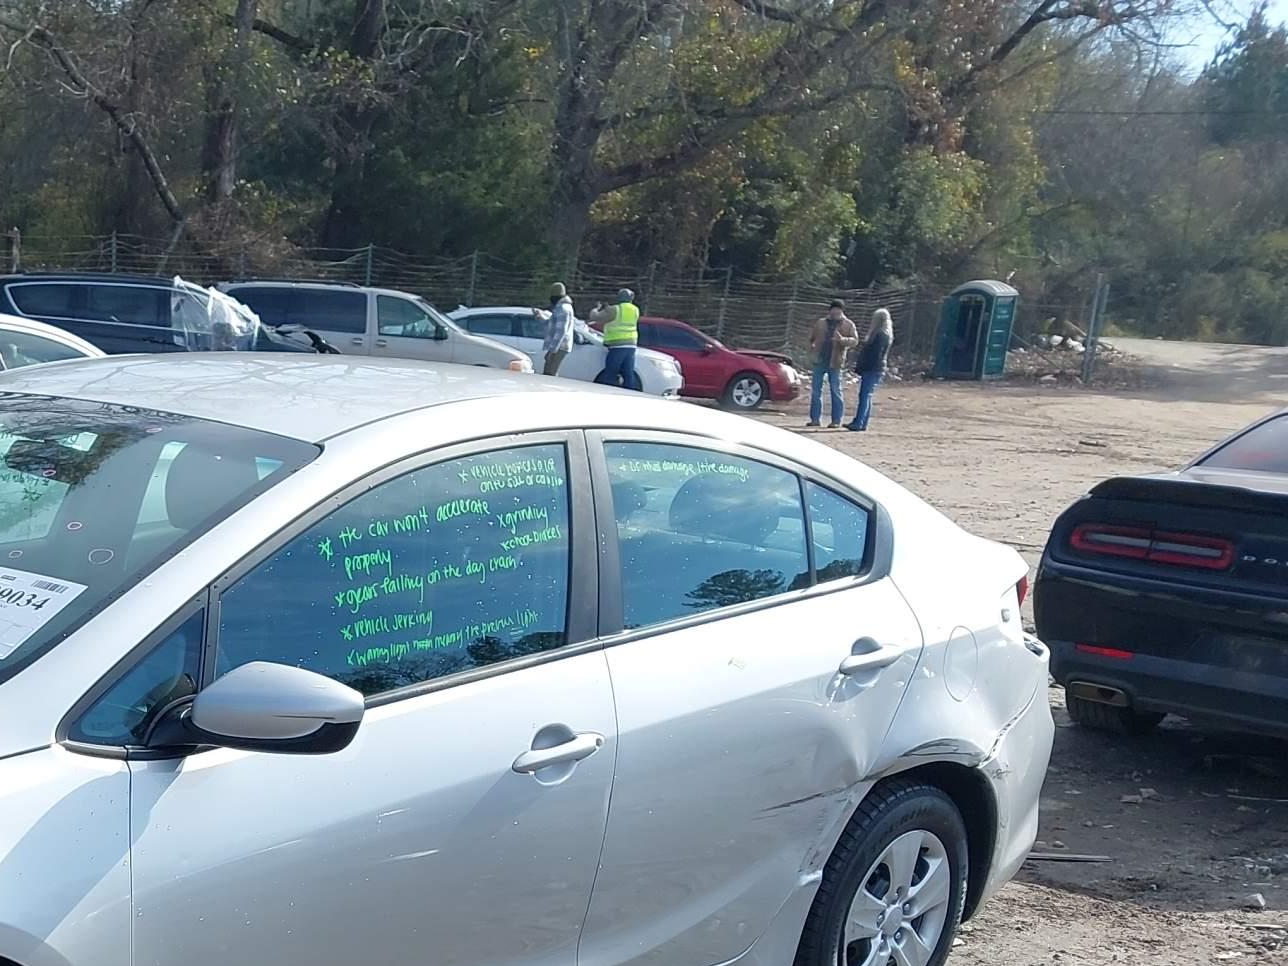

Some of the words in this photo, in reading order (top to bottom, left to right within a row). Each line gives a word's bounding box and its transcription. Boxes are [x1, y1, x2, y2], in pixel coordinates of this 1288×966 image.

[368, 519, 390, 537] car
[436, 498, 490, 522] accelerate
[344, 549, 392, 580] properly
[427, 569, 441, 584] on
[443, 564, 462, 578] the
[465, 559, 486, 584] day
